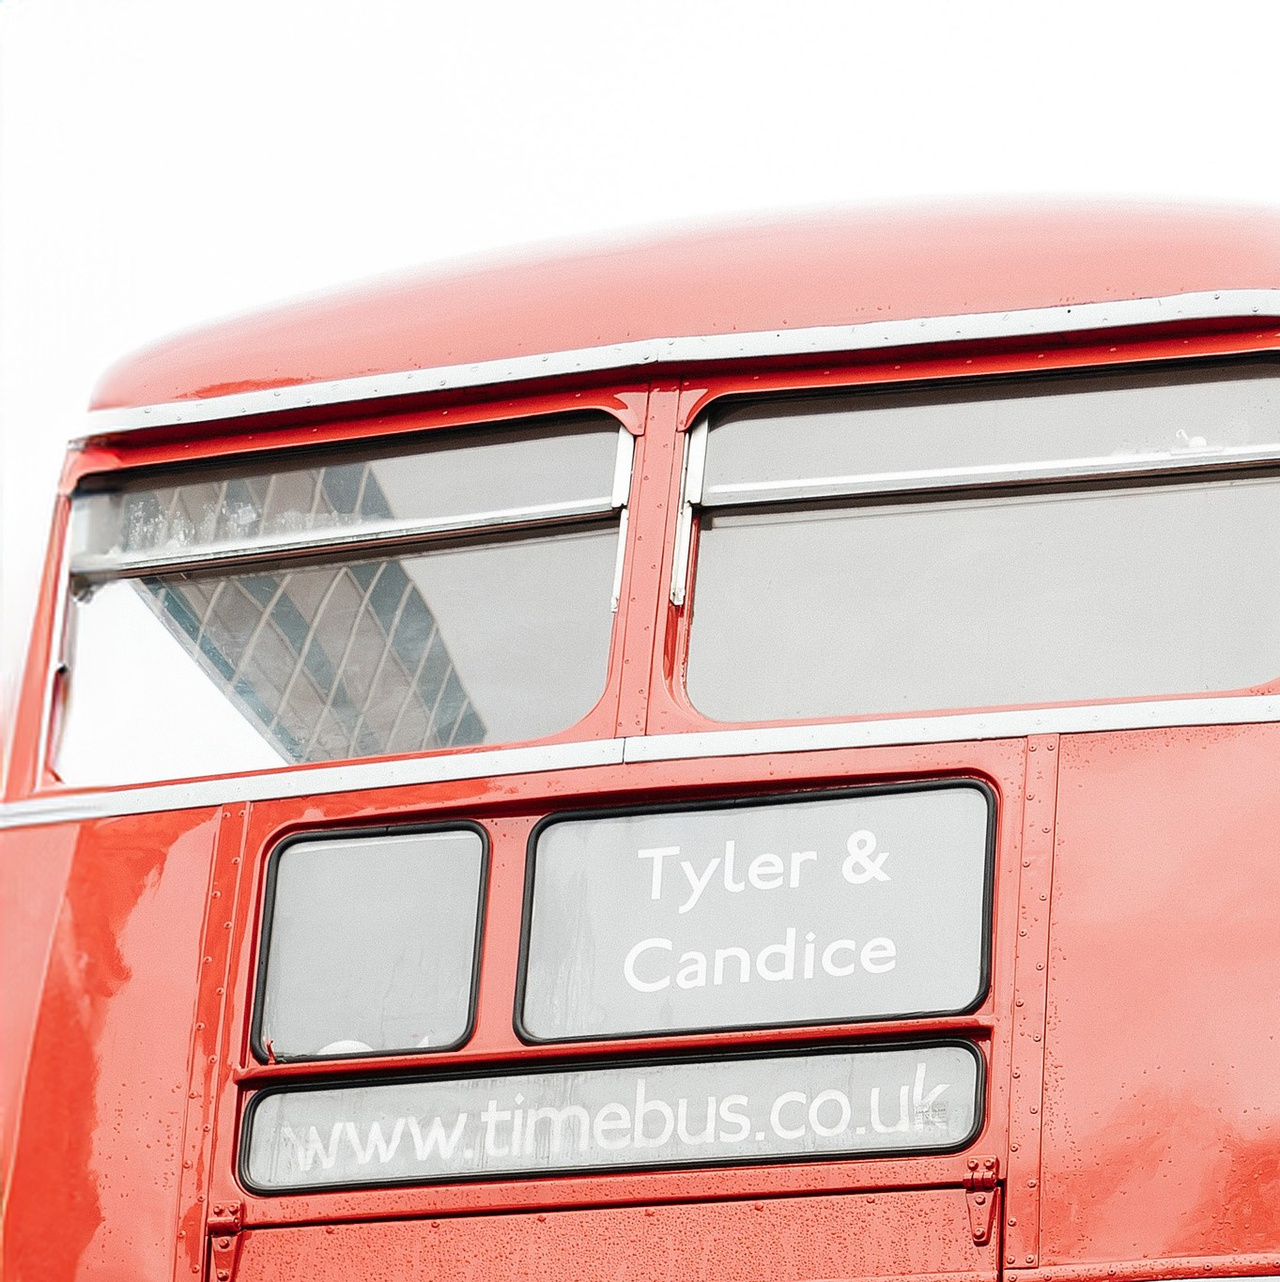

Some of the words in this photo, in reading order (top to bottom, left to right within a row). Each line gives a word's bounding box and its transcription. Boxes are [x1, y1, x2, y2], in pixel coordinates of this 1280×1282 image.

[637, 840, 818, 914] Tyler
[841, 828, 892, 885] &
[622, 929, 898, 994] Candice
[281, 1061, 951, 1173] www.timebus.co.uk
